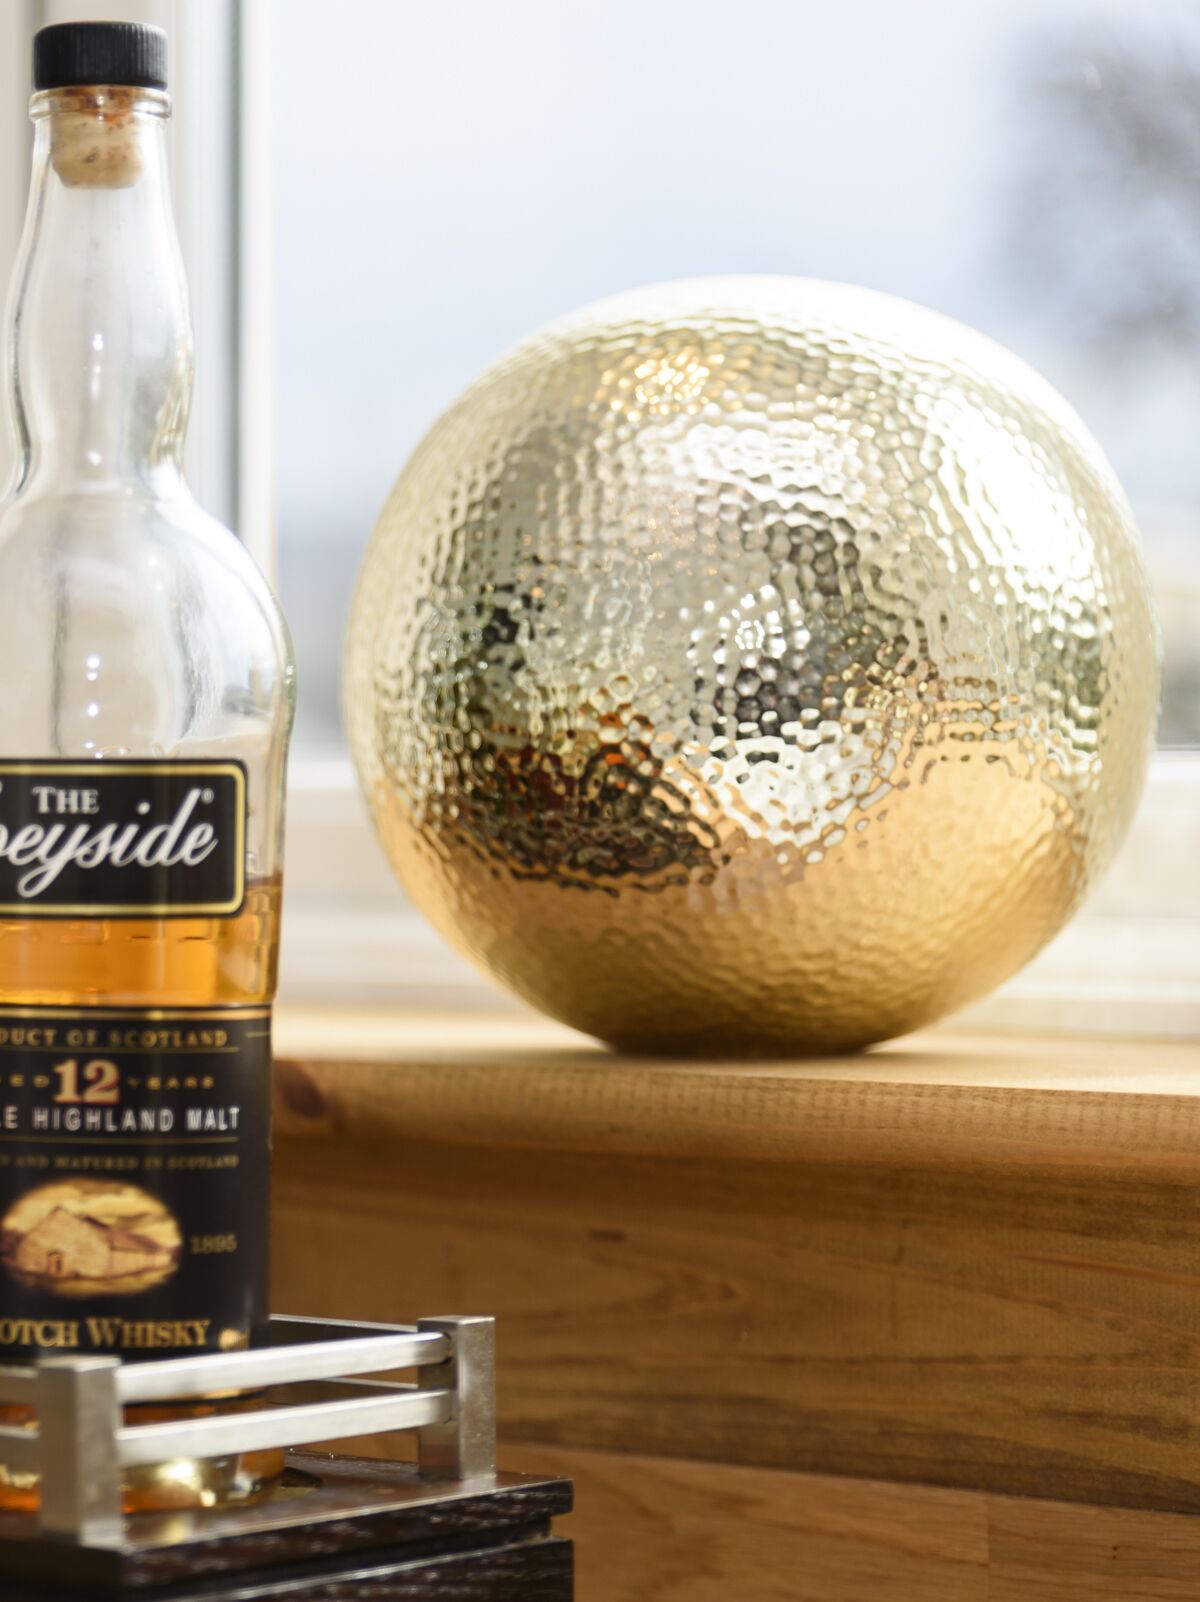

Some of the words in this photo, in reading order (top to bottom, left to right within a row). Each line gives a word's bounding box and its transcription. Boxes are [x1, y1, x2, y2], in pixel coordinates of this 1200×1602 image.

[32, 785, 100, 815] THE
[67, 1028, 98, 1048] OF
[108, 1029, 229, 1048] SCOTLAND
[52, 1058, 121, 1105] 12
[32, 1105, 175, 1132] HIGHLAND
[185, 1106, 240, 1131] MALT
[85, 1316, 212, 1348] WHISKY
